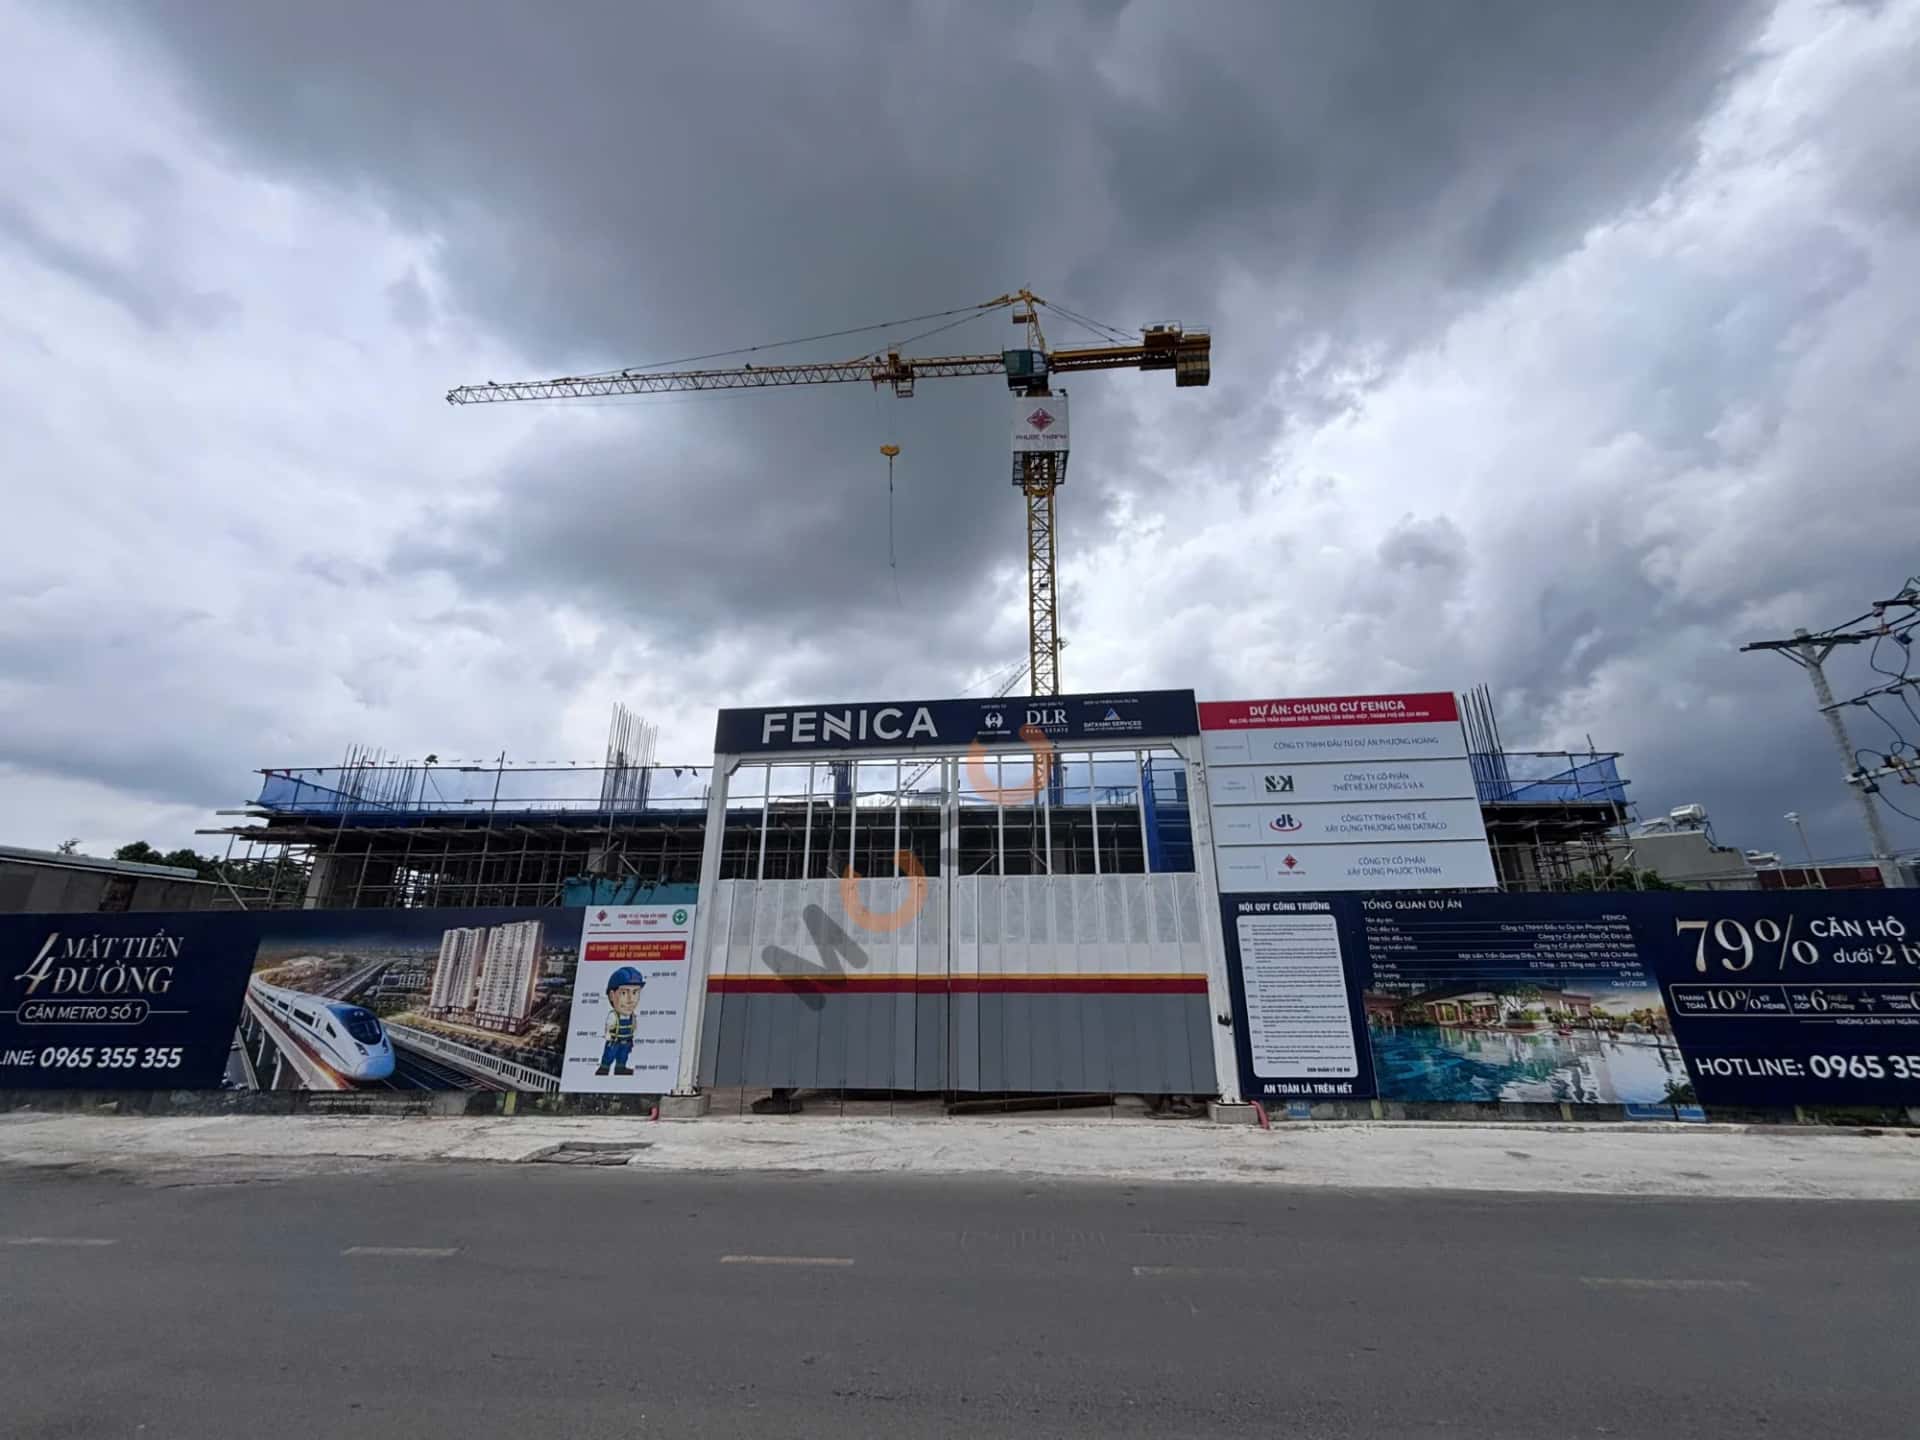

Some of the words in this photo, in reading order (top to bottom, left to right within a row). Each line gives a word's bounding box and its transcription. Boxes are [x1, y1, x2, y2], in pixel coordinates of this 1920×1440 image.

[1026, 709, 1068, 725] DLR
[1249, 704, 1267, 717] DỰ
[1270, 703, 1291, 716] ÁN:
[1293, 702, 1337, 715] CHUNG
[1339, 700, 1359, 712] CƯ
[1361, 700, 1406, 712] FENICA
[762, 707, 938, 744] FENICA
[1394, 900, 1426, 910] QUAN
[1446, 898, 1463, 909] ÁN
[1810, 916, 1863, 937] CĂN
[1866, 915, 1905, 942] HỘ
[122, 928, 185, 959] TIỀN
[1675, 913, 1819, 972] 79%
[13, 932, 60, 994] 4
[1833, 947, 1874, 964] dưới
[1876, 944, 1897, 965] 2
[52, 960, 174, 994] ĐƯỜNG
[1707, 988, 1761, 1011] 10%
[1810, 989, 1828, 1011] 6
[57, 1006, 109, 1019] METRO
[109, 1003, 132, 1020] SỐ
[134, 1006, 143, 1019] 1
[39, 1047, 95, 1068] 0965
[97, 1047, 139, 1068] 355
[141, 1047, 184, 1068] 355
[1695, 1057, 1806, 1076] HOTLINE:
[1809, 1055, 1885, 1079] 0965
[1264, 1083, 1276, 1094] AN
[1277, 1082, 1300, 1094] TOÀN
[1313, 1082, 1336, 1094] TRÊN
